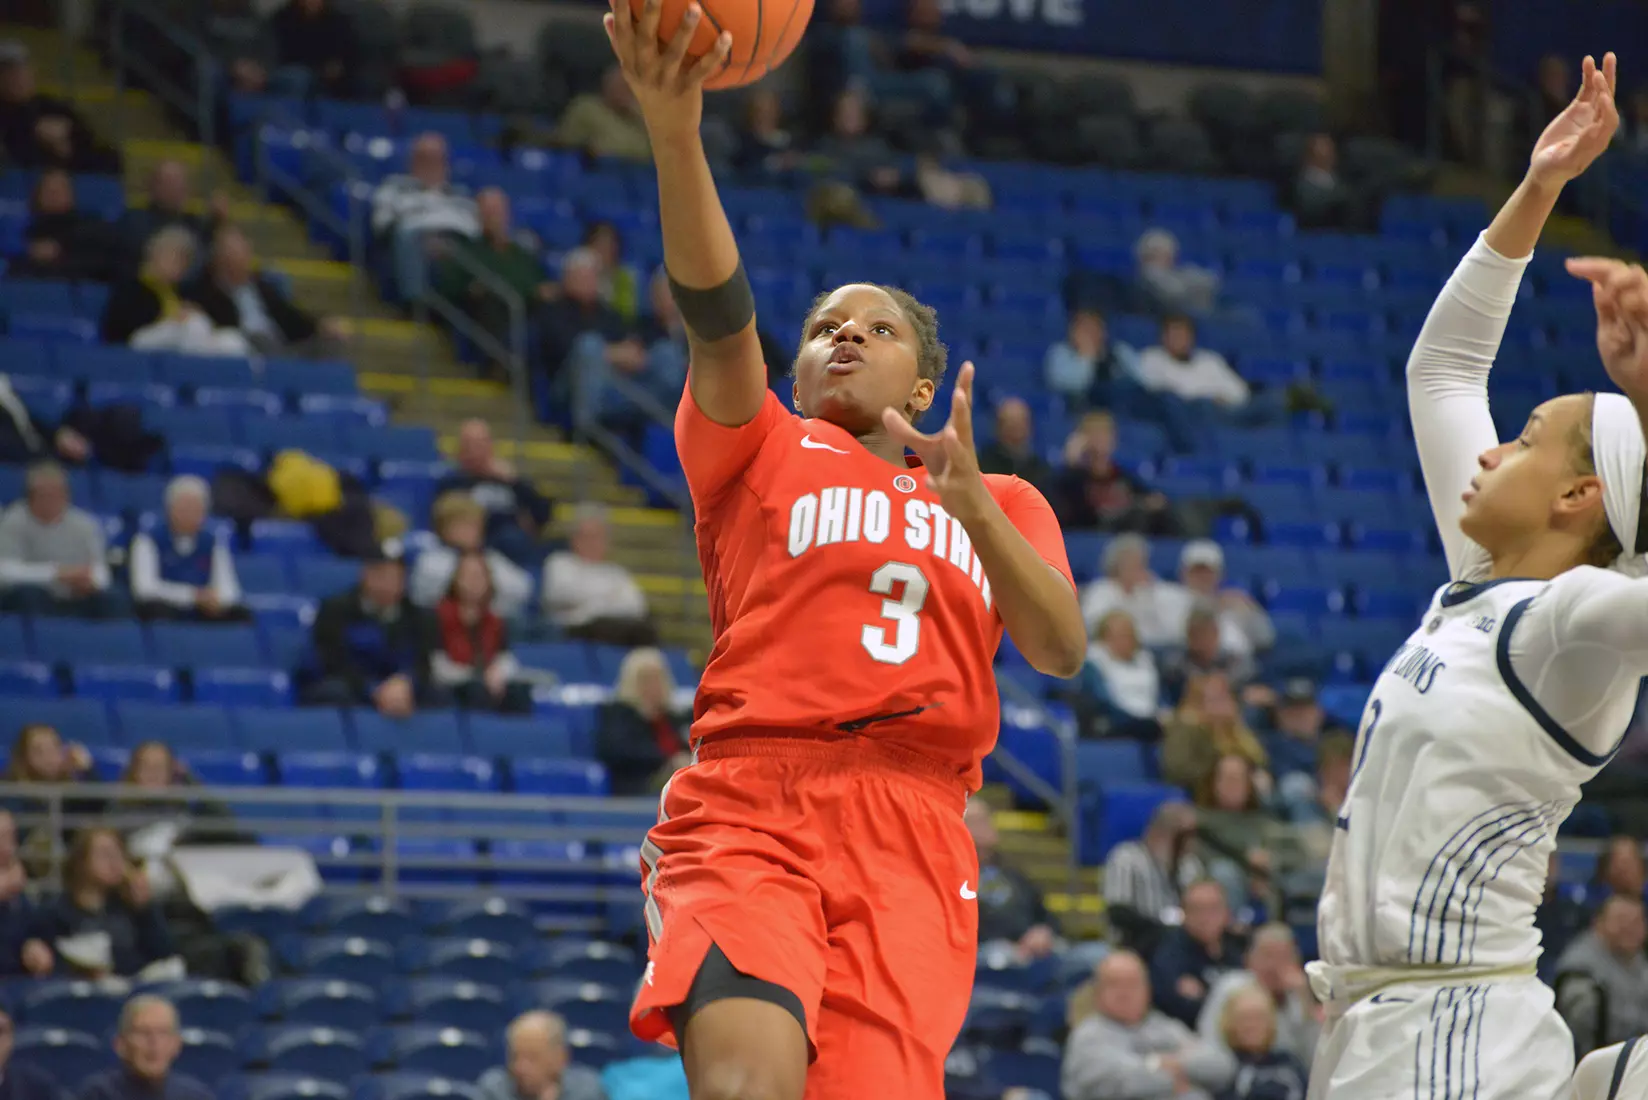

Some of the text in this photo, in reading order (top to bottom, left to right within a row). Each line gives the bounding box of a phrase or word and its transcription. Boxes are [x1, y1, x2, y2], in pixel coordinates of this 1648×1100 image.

[788, 486, 992, 614] OHIO STA
[860, 560, 930, 665] 3
